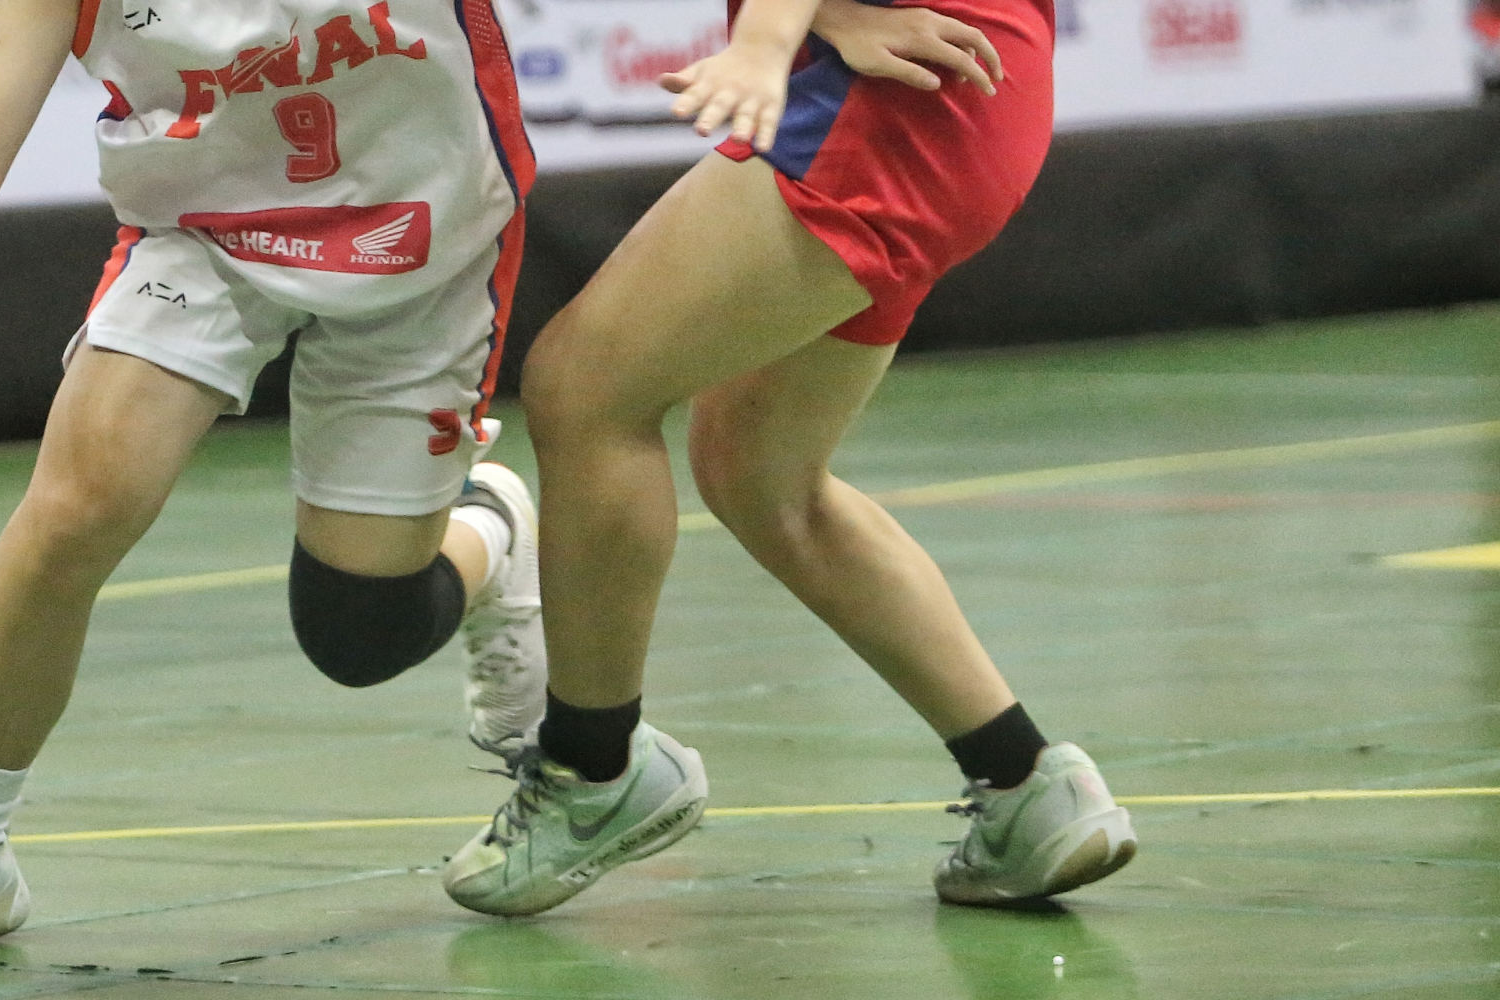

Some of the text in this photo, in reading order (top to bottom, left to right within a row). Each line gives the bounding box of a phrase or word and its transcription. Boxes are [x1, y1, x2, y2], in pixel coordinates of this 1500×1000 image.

[271, 91, 342, 184] 9
[240, 229, 325, 262] HEART.
[350, 254, 416, 266] HONDA
